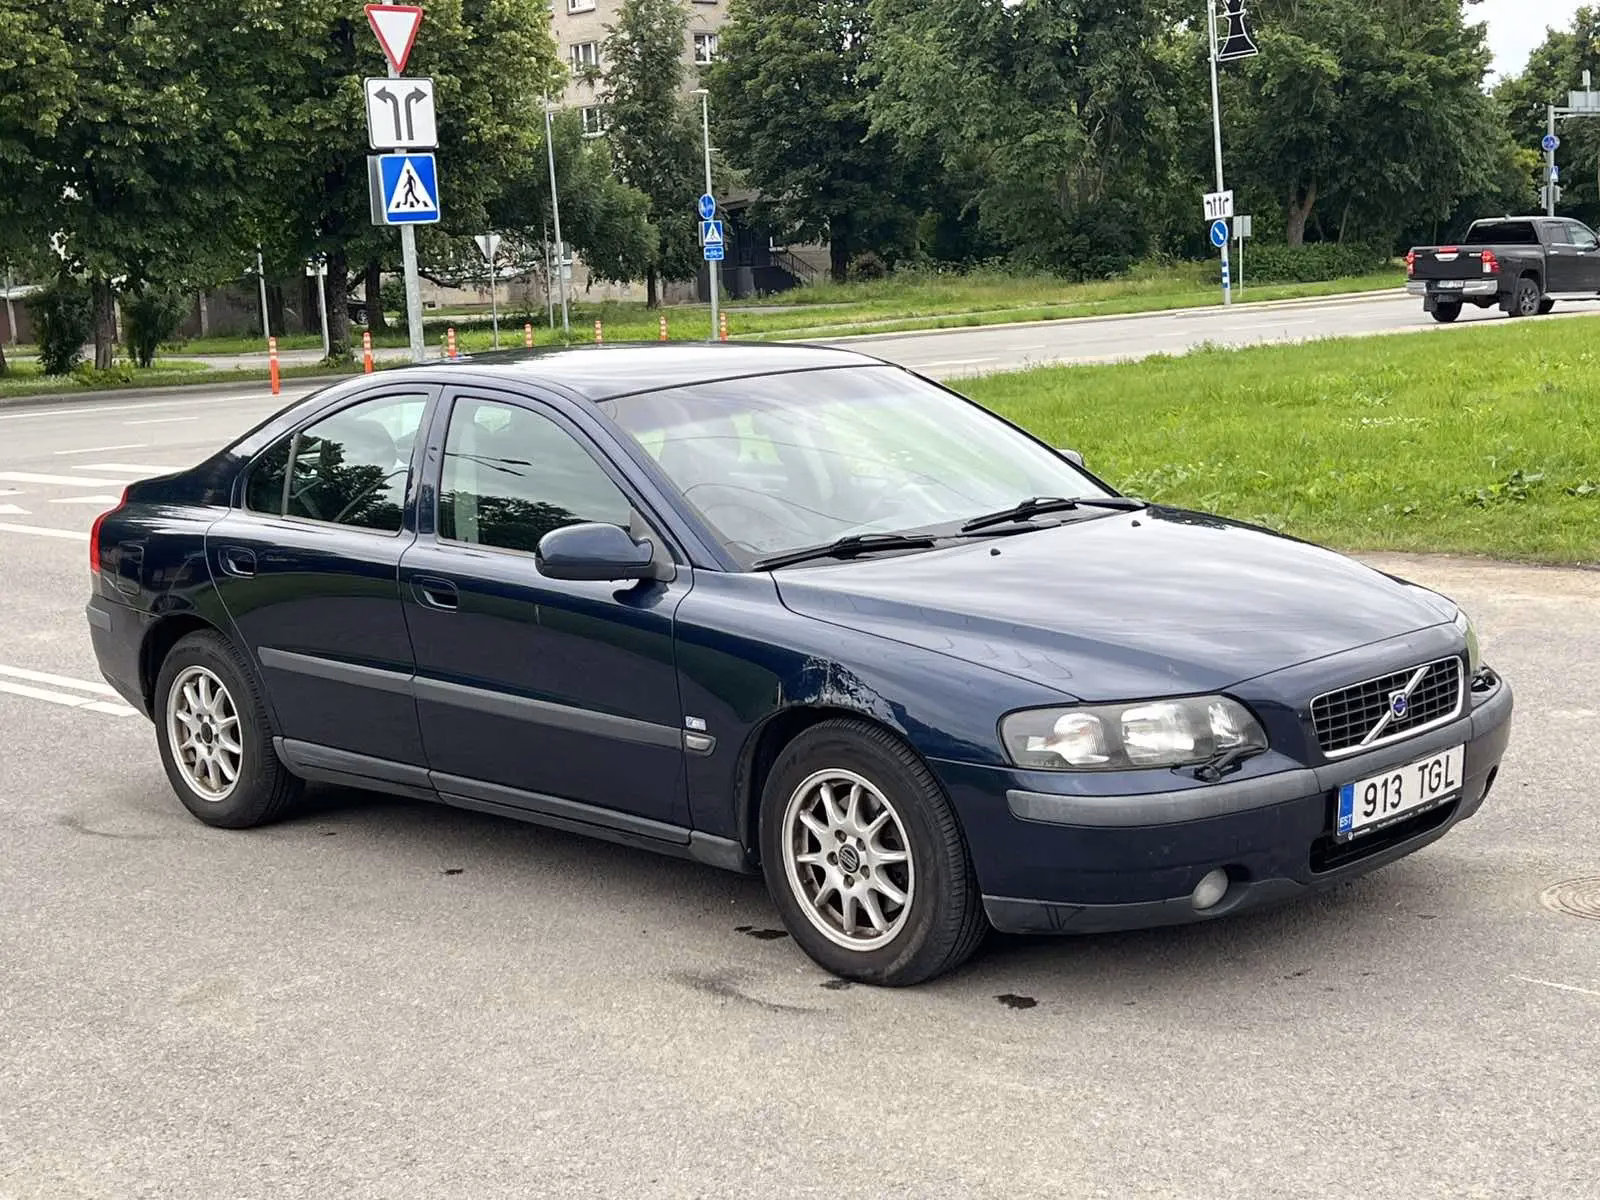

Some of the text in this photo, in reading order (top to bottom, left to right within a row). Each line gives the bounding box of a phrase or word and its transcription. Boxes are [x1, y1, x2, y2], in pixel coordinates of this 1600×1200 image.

[1363, 754, 1455, 818] 913 TGL
[1340, 814, 1353, 828] EST
